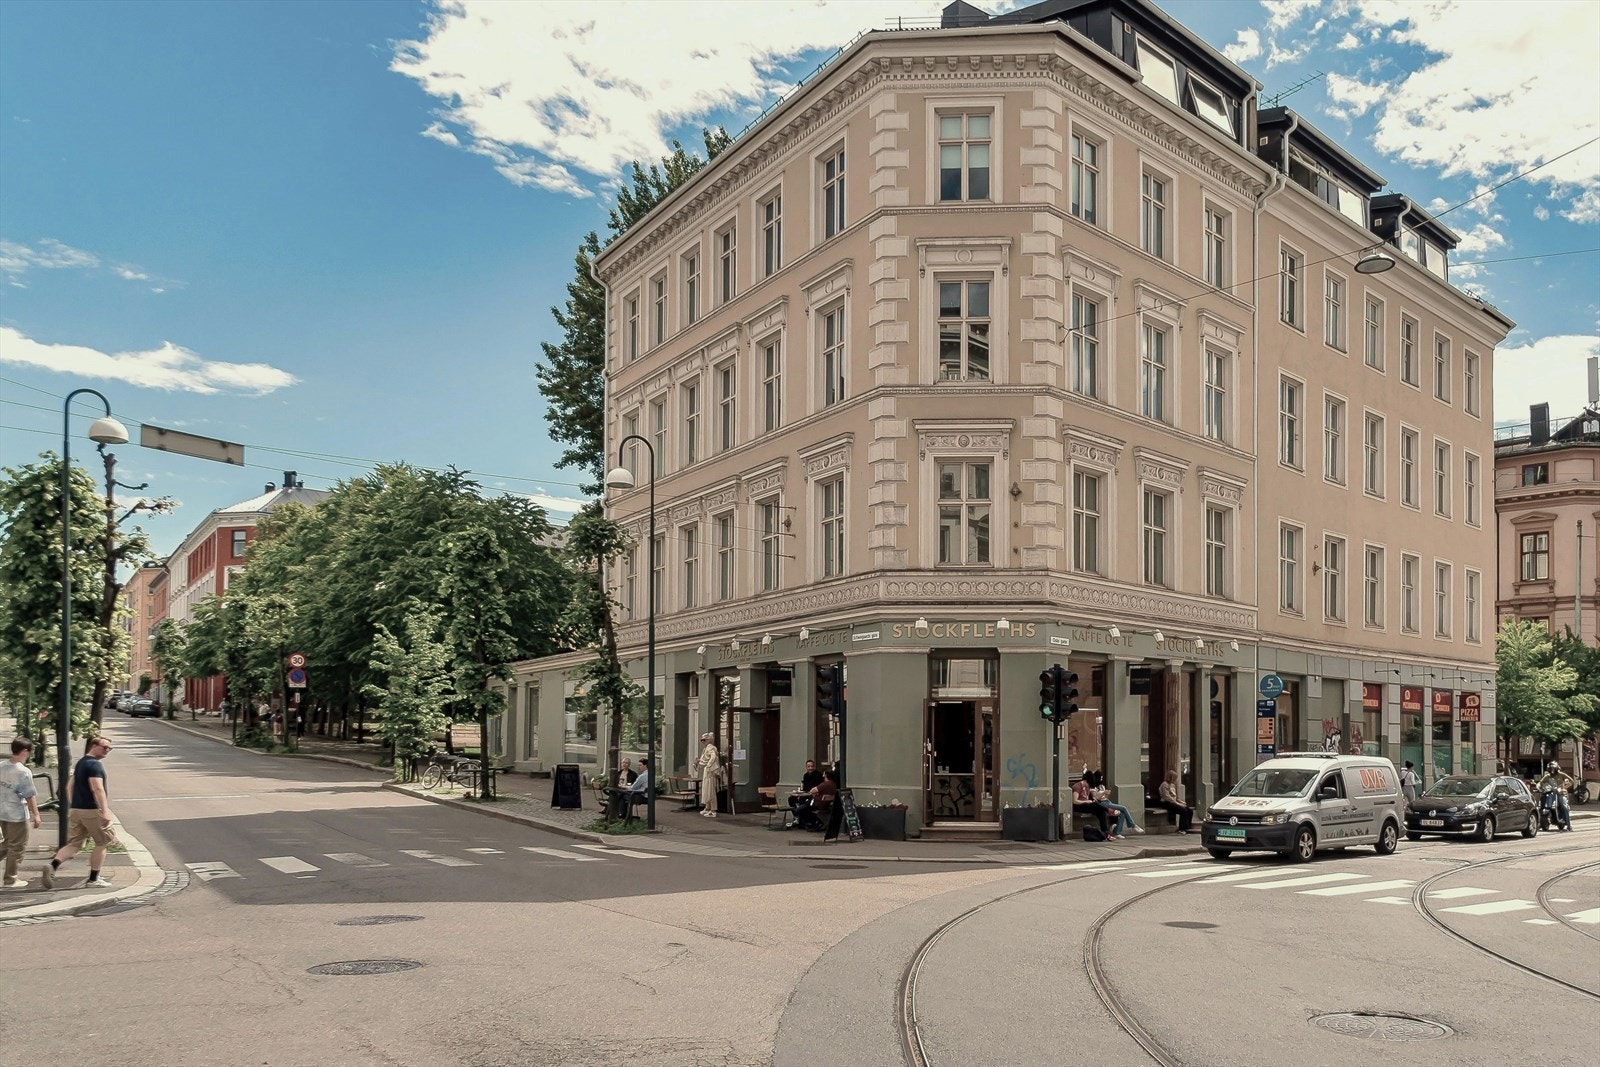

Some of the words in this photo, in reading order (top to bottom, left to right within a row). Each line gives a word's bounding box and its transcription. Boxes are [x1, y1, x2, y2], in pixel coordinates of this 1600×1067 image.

[1072, 628, 1102, 644] KAFFE
[1122, 634, 1134, 648] TE
[292, 656, 303, 665] 30
[1460, 708, 1479, 716] PIZZA
